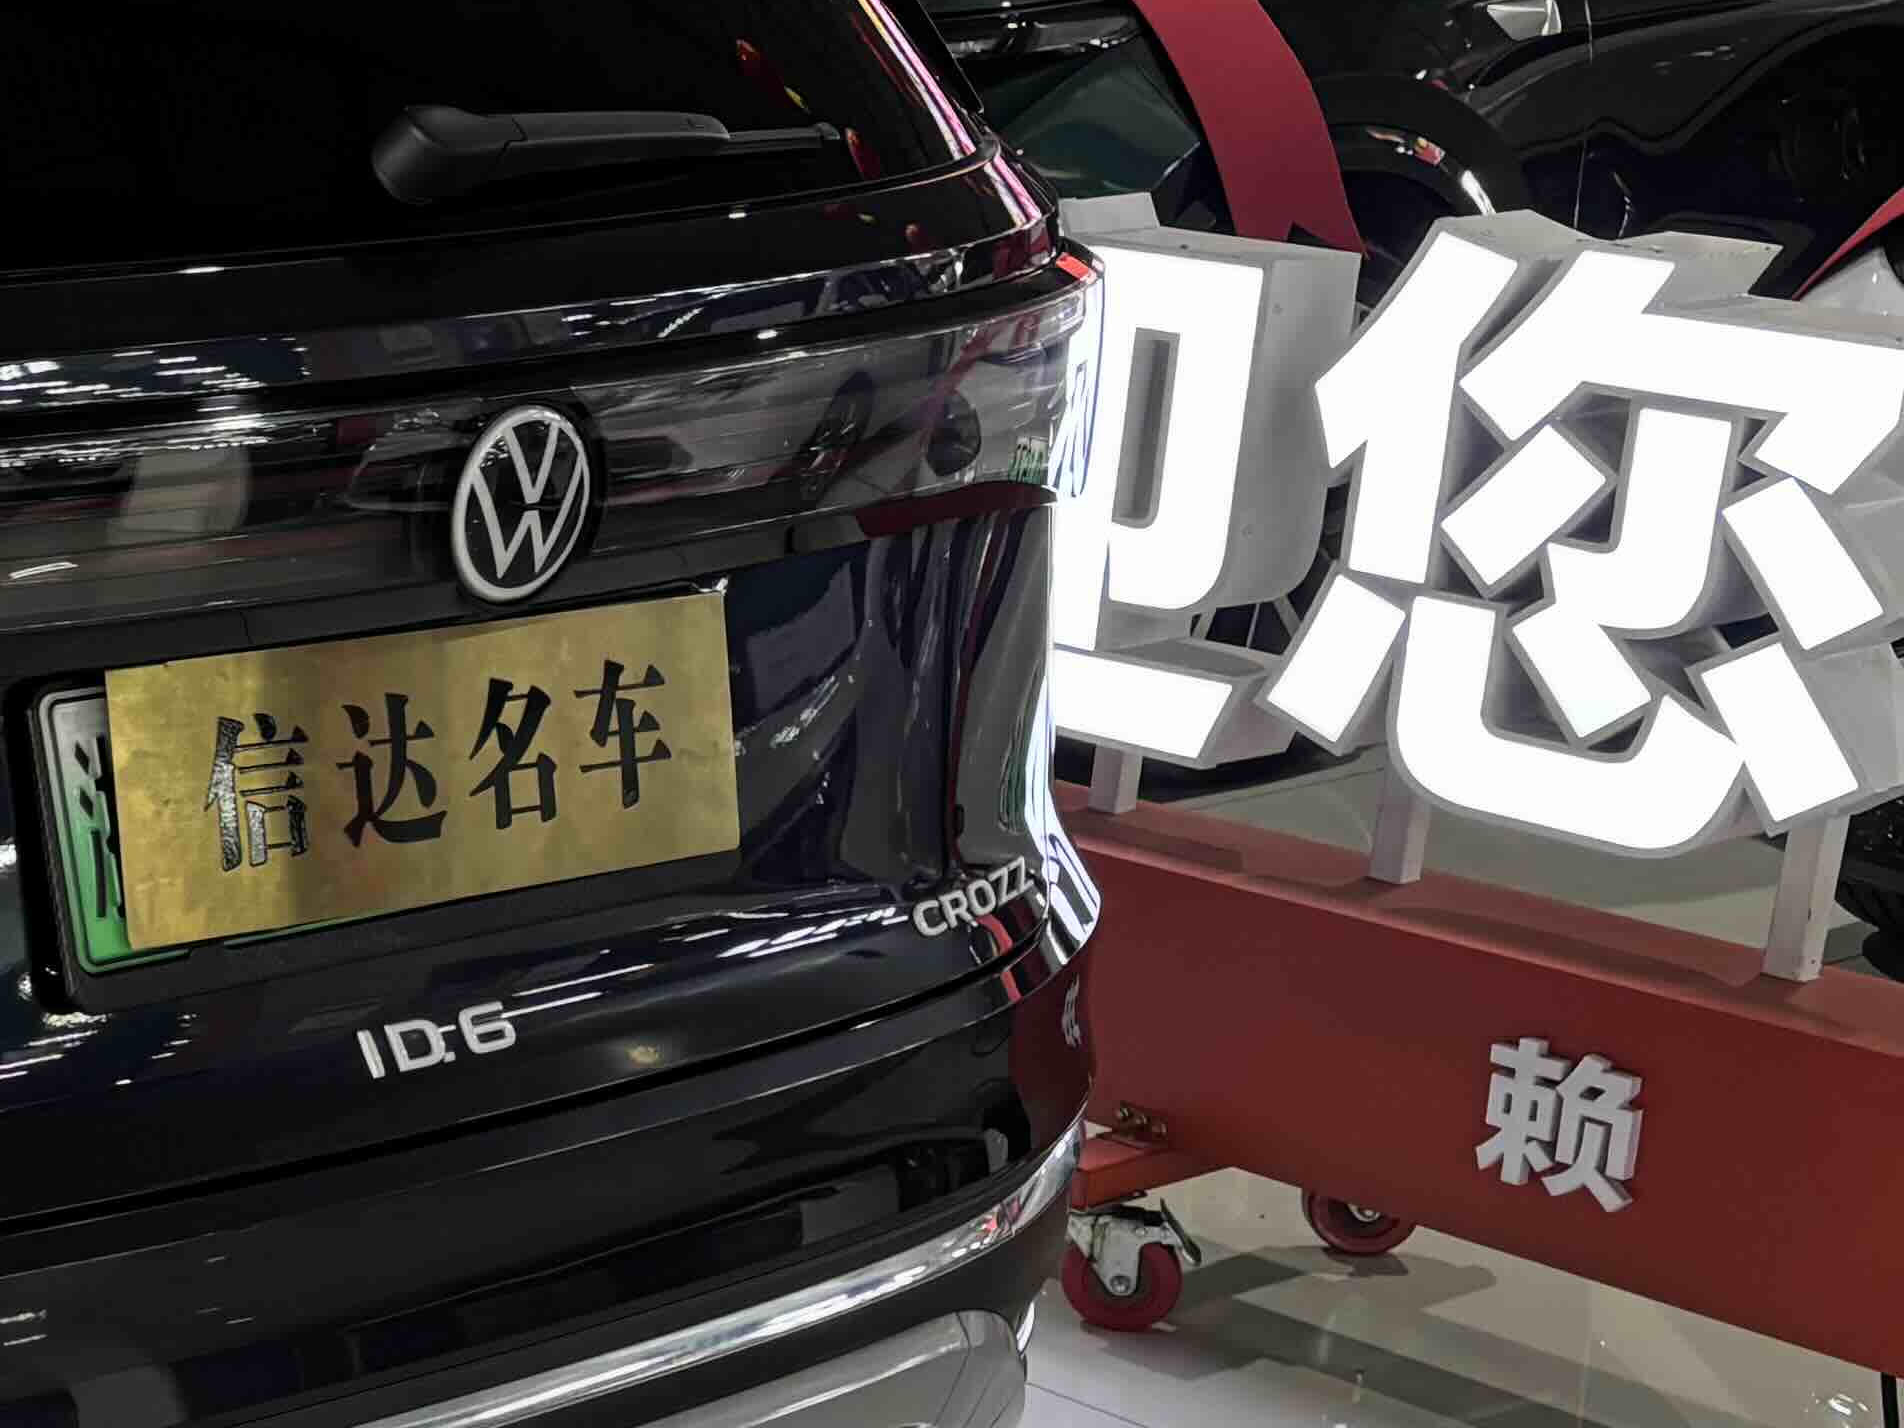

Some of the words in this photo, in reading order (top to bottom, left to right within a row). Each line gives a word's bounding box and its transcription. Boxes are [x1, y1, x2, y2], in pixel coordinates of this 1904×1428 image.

[202, 659, 672, 873] 信达名车
[912, 855, 1034, 937] CROZZ
[354, 1001, 519, 1080] ID.6
[1480, 1035, 1644, 1214] 赖
